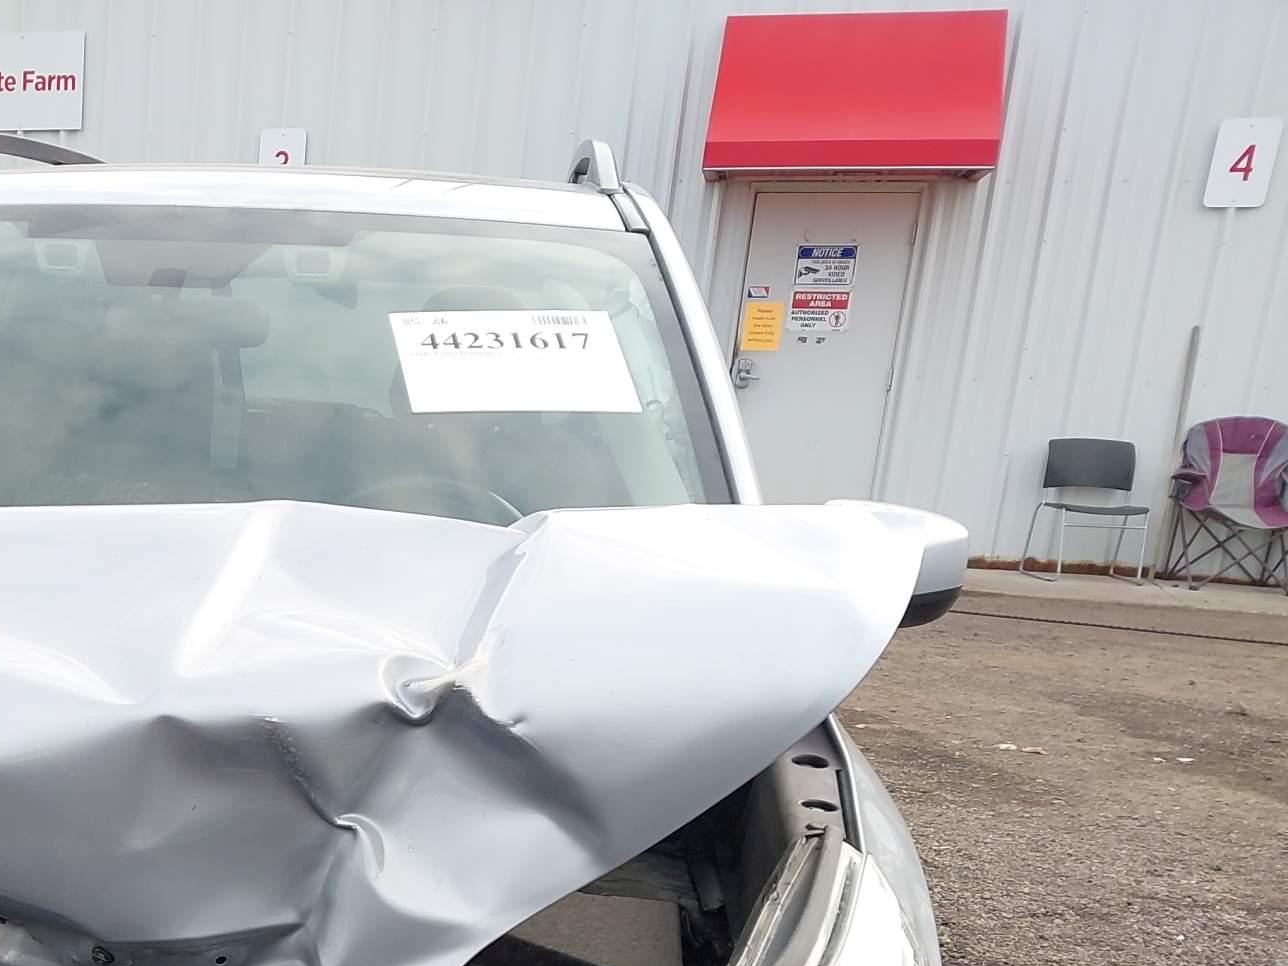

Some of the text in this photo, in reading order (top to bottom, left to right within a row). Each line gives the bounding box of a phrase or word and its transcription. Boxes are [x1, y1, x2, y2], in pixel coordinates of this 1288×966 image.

[22, 70, 76, 92] Farm
[1229, 144, 1257, 182] 4
[811, 247, 844, 258] NOTICE
[795, 293, 849, 301] RESTRICTED
[809, 300, 832, 308] AREA
[420, 331, 590, 350] 44231617
